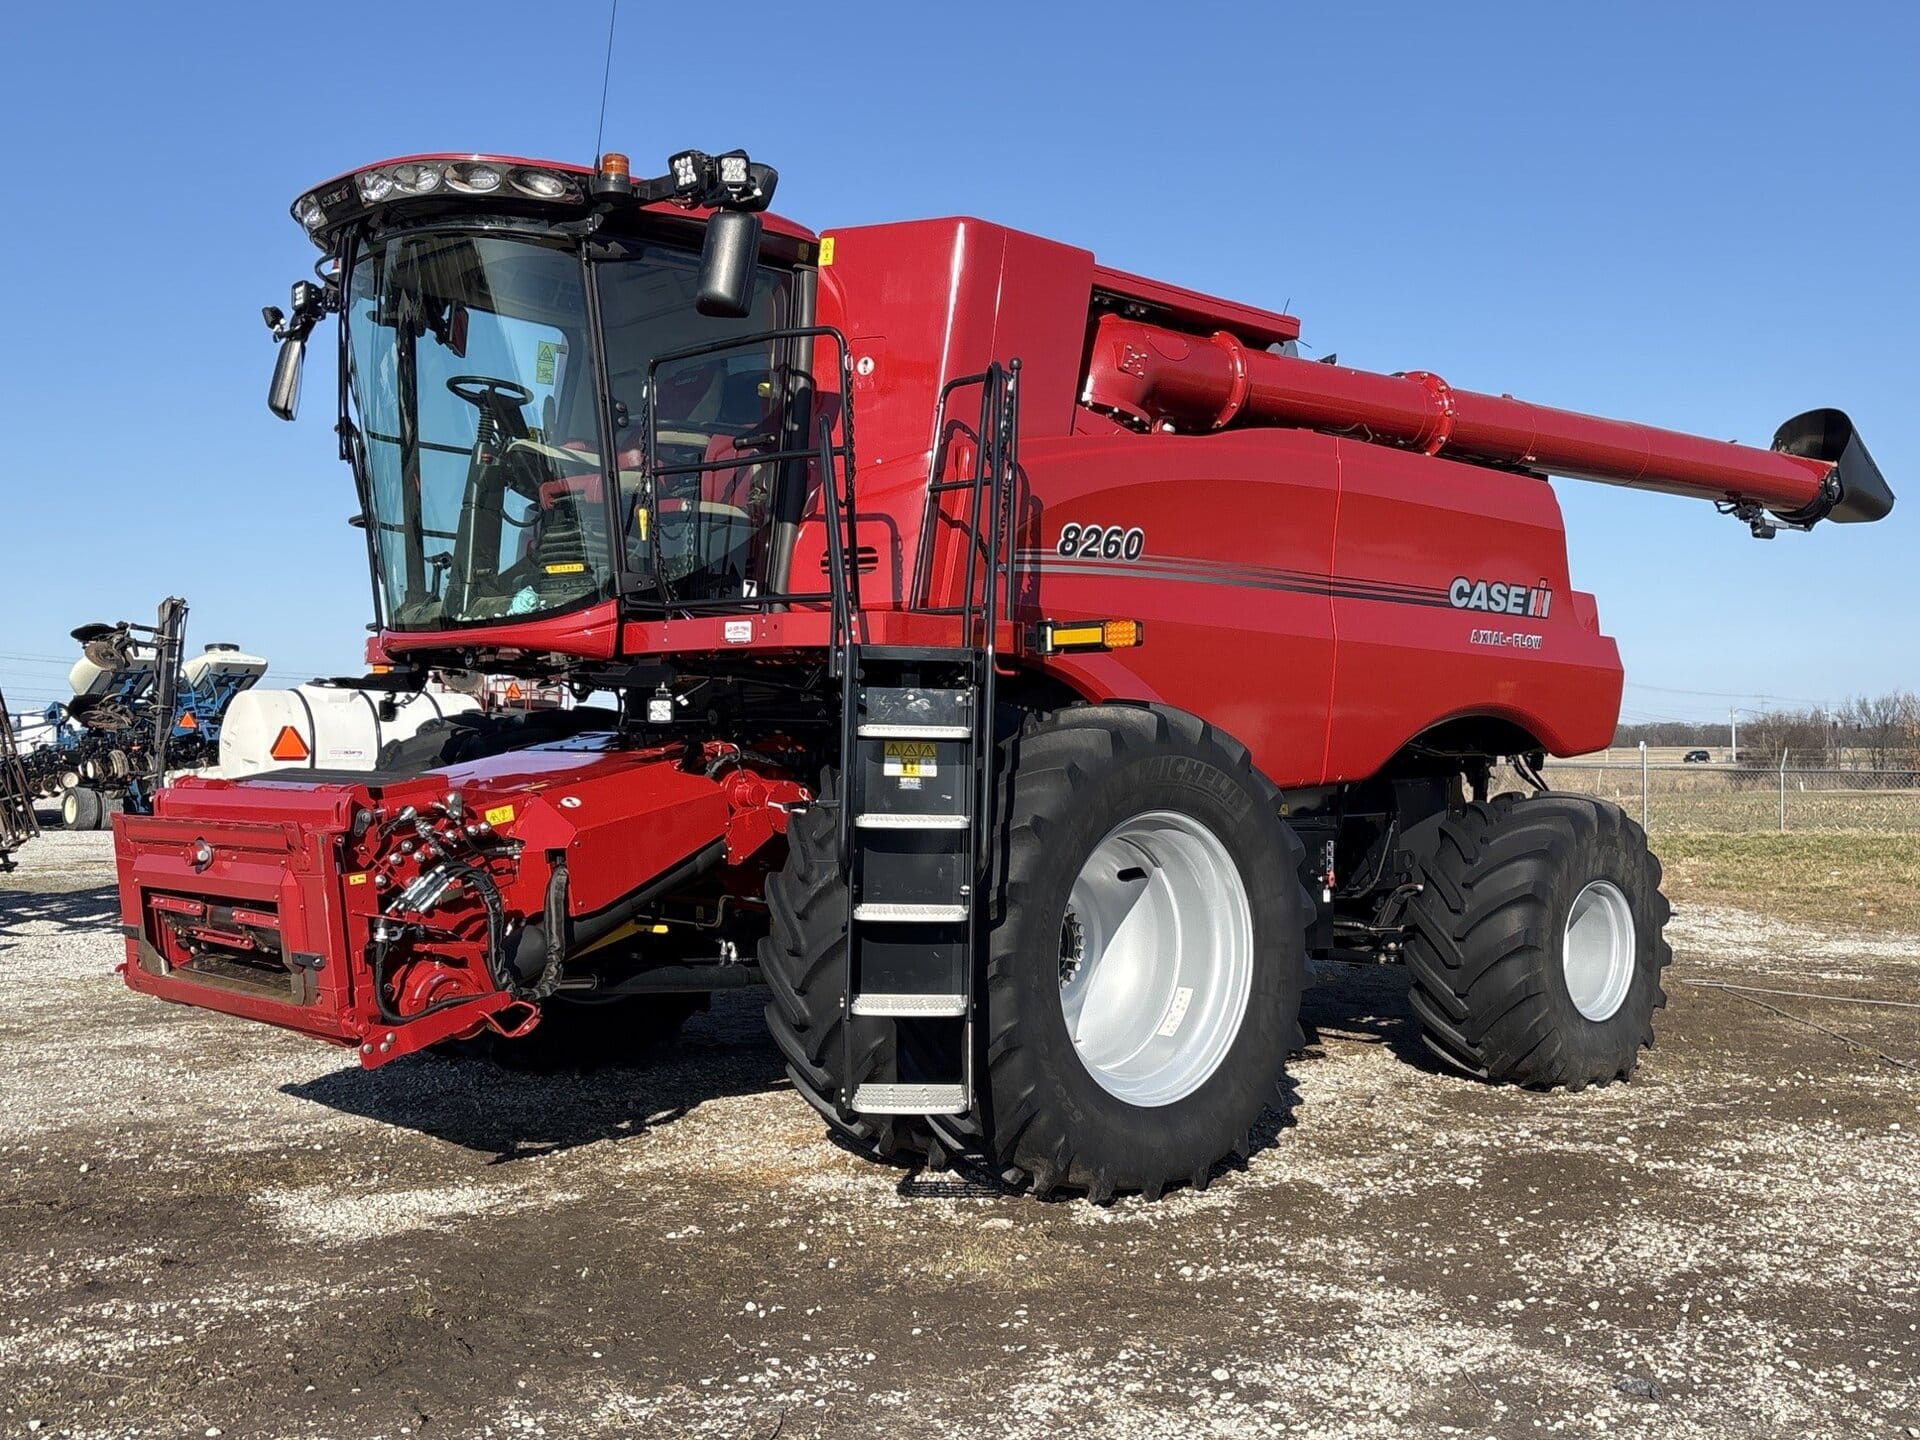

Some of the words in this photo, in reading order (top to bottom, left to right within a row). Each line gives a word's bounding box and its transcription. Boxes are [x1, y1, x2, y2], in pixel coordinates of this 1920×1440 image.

[1057, 522, 1145, 563] 8260
[745, 581, 756, 599] 7
[1448, 575, 1527, 615] CASE
[1470, 629, 1542, 650] AXIAL-FLOW
